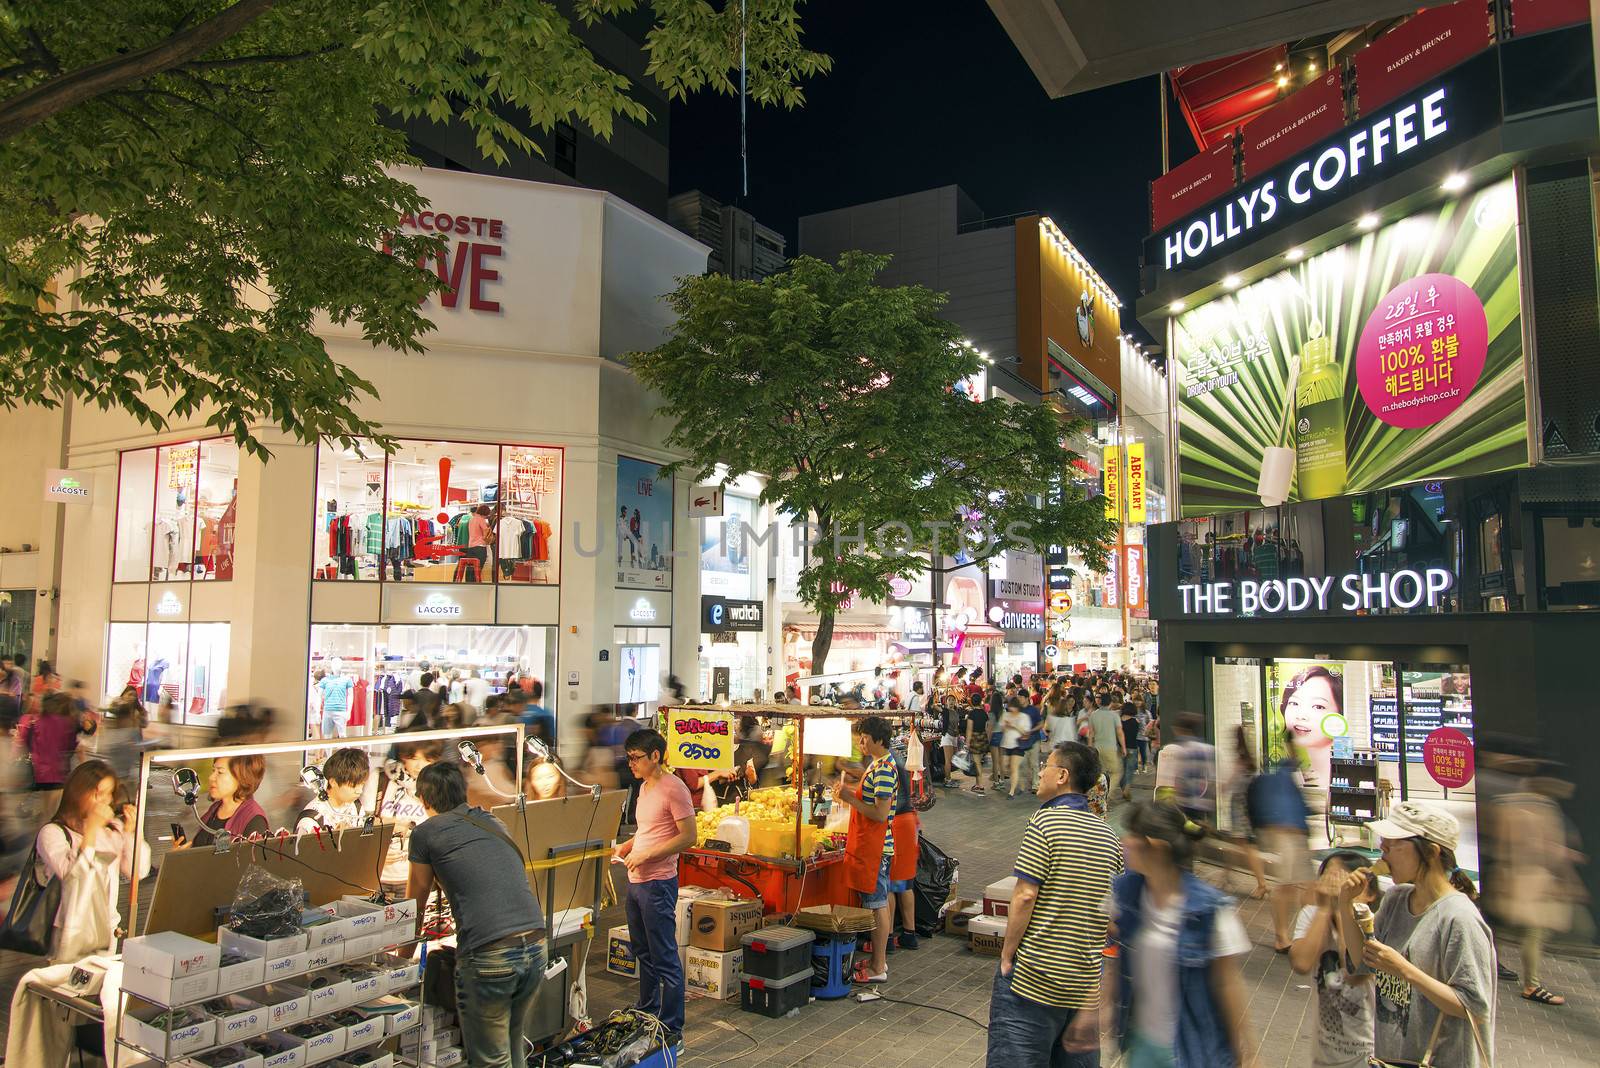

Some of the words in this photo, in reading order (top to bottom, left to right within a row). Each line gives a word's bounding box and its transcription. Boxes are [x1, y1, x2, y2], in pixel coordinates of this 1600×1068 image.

[1386, 50, 1413, 73] BAKERY
[1414, 47, 1421, 56] &
[1422, 29, 1452, 51] BRUNCH
[1256, 136, 1276, 150] COFFEE
[1281, 126, 1292, 136] TEA
[1298, 103, 1328, 126] BEVERAGE
[1164, 179, 1278, 270] HOLLYS
[1287, 88, 1448, 204] COFFEE
[1171, 186, 1189, 200] BAKERY
[399, 211, 503, 238] ACOSTE
[1385, 291, 1419, 320] 28일
[1425, 285, 1440, 307] 후
[1379, 326, 1412, 350] 만족하지
[1415, 320, 1433, 340] 못할
[1437, 313, 1456, 333] 경우
[1380, 344, 1425, 374] 100%
[1431, 334, 1460, 362] 환불
[1186, 381, 1207, 398] DROPS
[1207, 379, 1215, 391] OF
[1215, 371, 1239, 388] YOUTH
[1385, 360, 1453, 396] 해드립니다
[1382, 388, 1461, 412] m.thebodyshop.co.kr
[51, 486, 89, 496] LACOSTE
[637, 480, 653, 497] LIVE
[1131, 456, 1141, 510] ABC-MART
[1000, 580, 1022, 595] CUSTOM
[1022, 583, 1040, 597] STUDIO
[1177, 581, 1232, 614] THE
[1241, 575, 1333, 613] BODY
[1341, 568, 1454, 611] SHOP
[418, 605, 460, 615] LACOSTE
[631, 609, 656, 619] LACOSTE
[729, 604, 760, 621] watch
[1000, 612, 1040, 629] CONVERSE
[1432, 754, 1452, 766] 100%
[381, 799, 425, 817] PARIS
[729, 907, 762, 924] Sunkist
